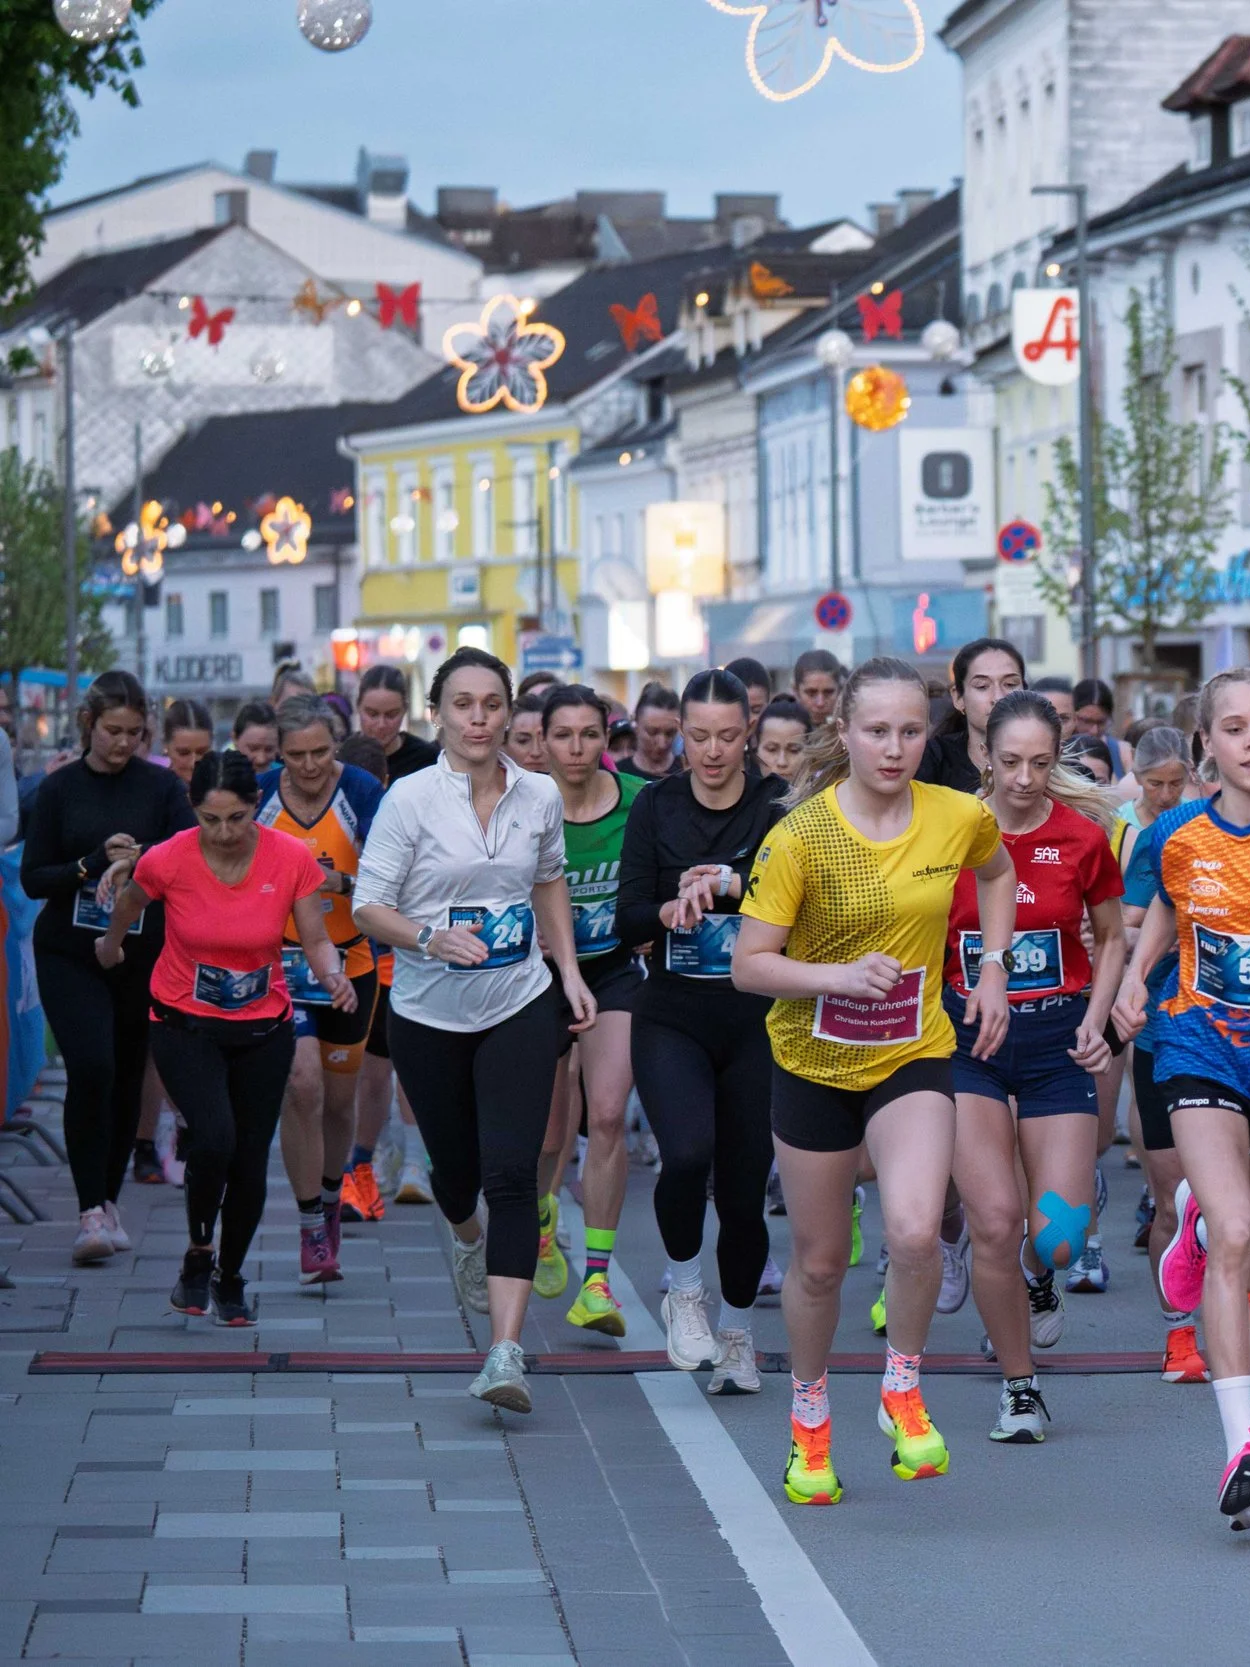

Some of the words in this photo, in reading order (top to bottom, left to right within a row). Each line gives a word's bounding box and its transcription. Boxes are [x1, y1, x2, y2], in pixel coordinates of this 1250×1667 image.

[1034, 846, 1060, 860] SAR
[493, 922, 523, 949] 24
[588, 914, 615, 938] 77
[1013, 949, 1047, 973] 39
